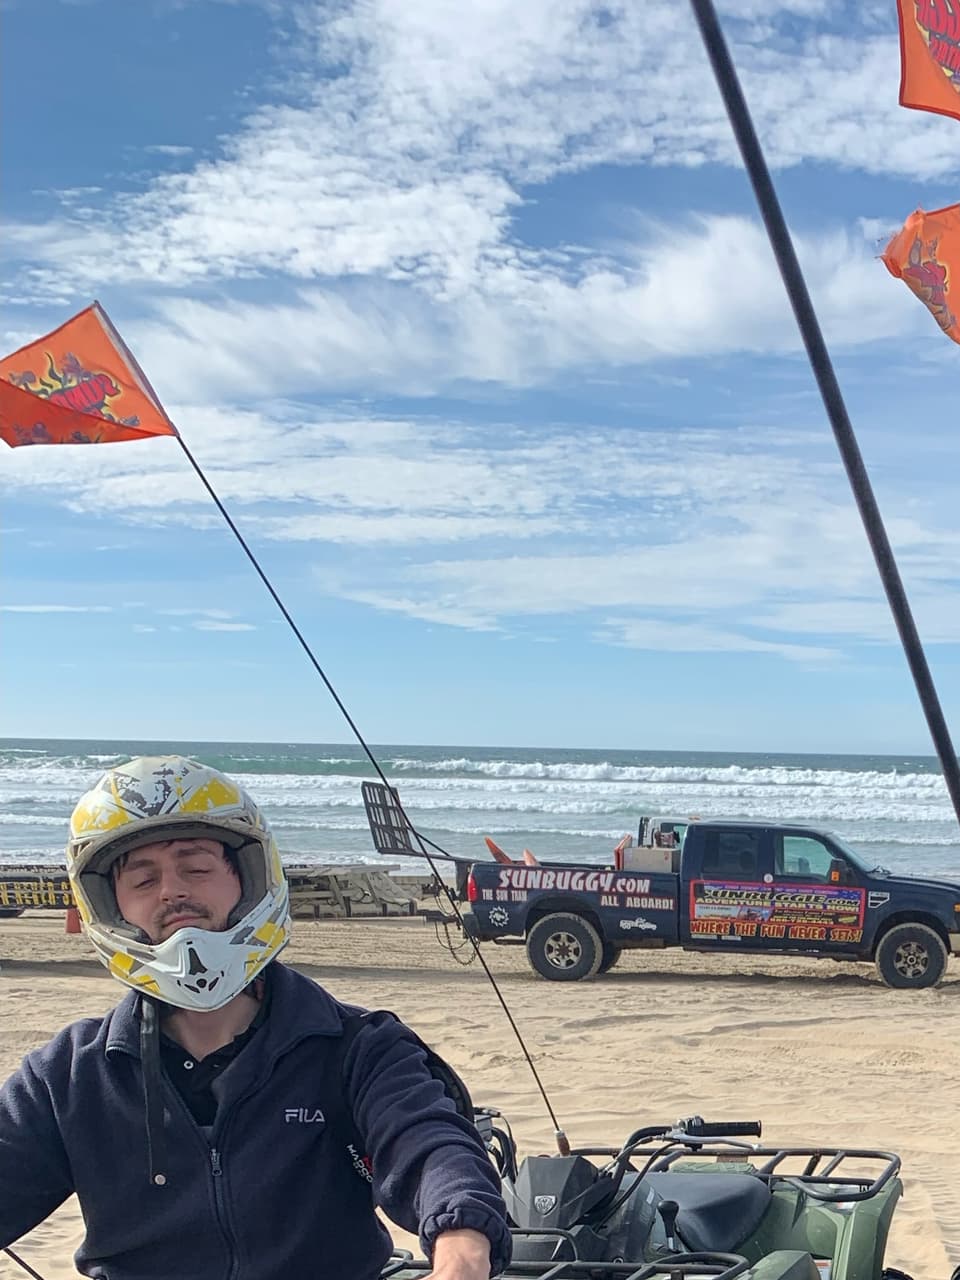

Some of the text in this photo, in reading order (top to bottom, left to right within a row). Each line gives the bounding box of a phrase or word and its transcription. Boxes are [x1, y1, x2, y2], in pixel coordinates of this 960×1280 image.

[499, 868, 650, 893] SUNBUGGY.COM
[601, 895, 674, 911] ALL ABOARD!
[691, 921, 863, 943] WHERE THE FUN NEVER SETS!
[285, 1108, 325, 1123] FILA
